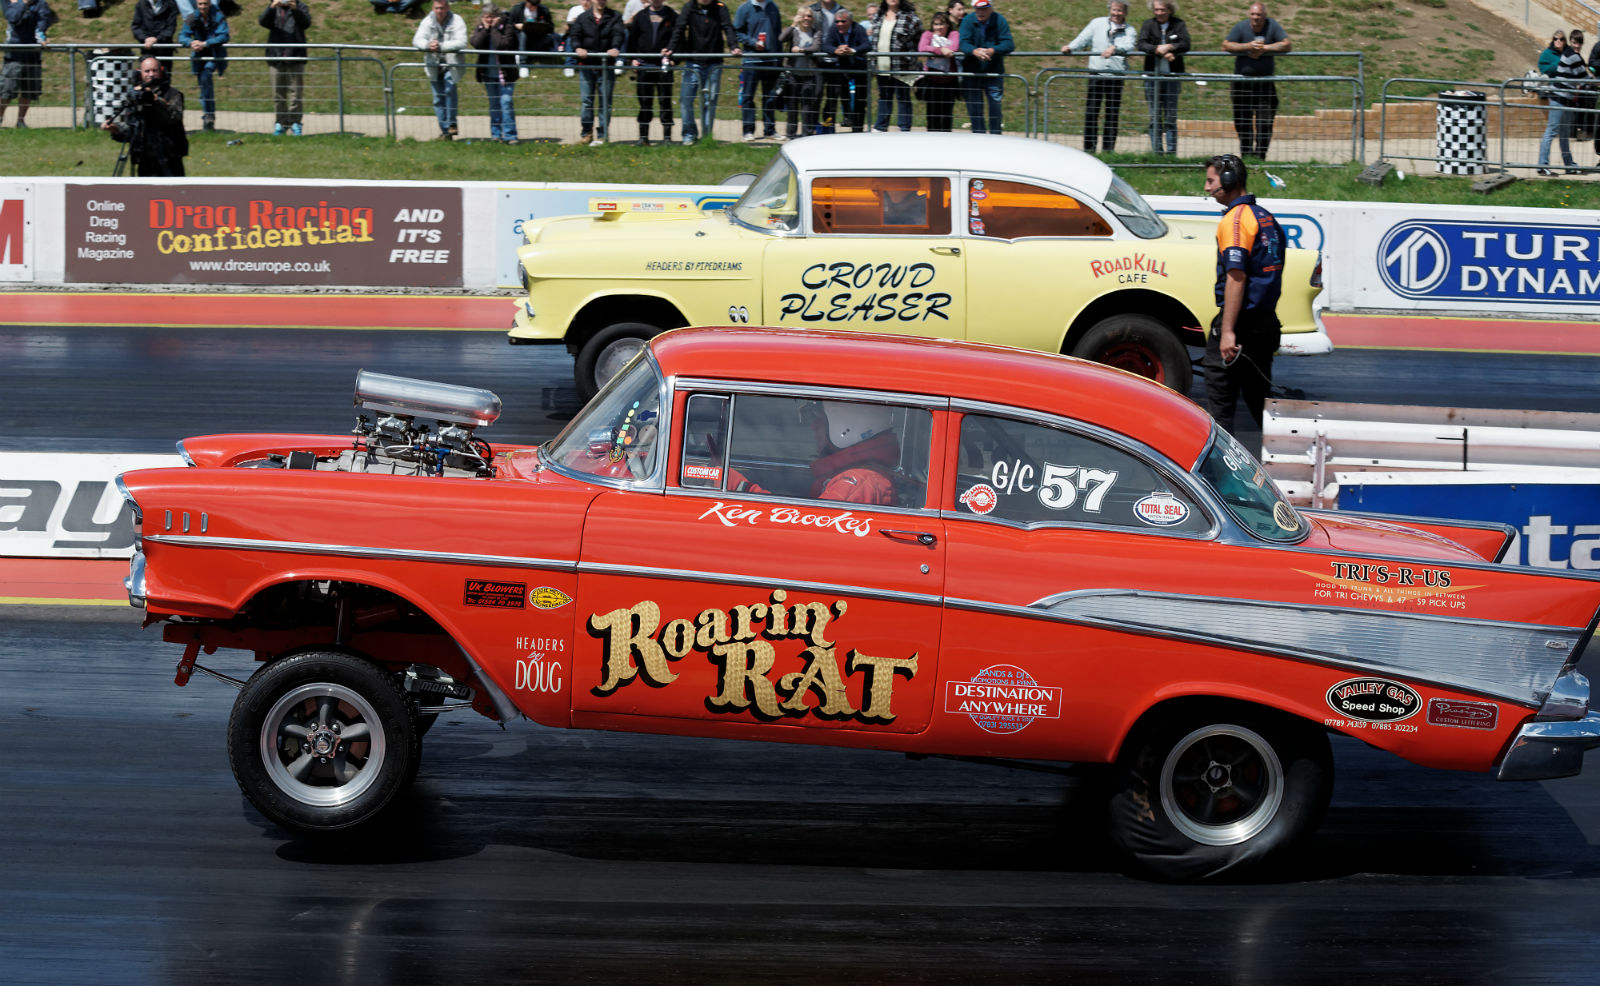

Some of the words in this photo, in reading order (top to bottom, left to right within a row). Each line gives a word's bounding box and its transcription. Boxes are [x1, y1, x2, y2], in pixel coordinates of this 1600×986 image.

[87, 200, 125, 212] Online
[90, 216, 119, 229] Drag
[149, 199, 237, 233] Drag
[249, 200, 373, 236] Racing
[394, 208, 444, 223] AND
[85, 232, 127, 246] Racing
[157, 218, 375, 255] Confidential
[397, 229, 442, 243] IT'S
[78, 247, 134, 261] Magazine
[1462, 231, 1600, 262] TUR
[389, 249, 450, 264] FREE
[190, 259, 331, 274] www.drceurope.co.uk
[645, 261, 683, 271] HEADERS
[685, 262, 695, 271] BY
[695, 262, 743, 271] PIPEDREAMS
[801, 262, 936, 289] CROWD
[1118, 273, 1148, 284] CAFE
[779, 292, 952, 322] PLEASER
[991, 459, 1035, 495] G/C
[1037, 462, 1119, 513] 57
[1141, 503, 1162, 514] TOTAL
[1164, 504, 1182, 516] SEAL
[698, 501, 763, 527] Ken
[769, 507, 874, 537] Brookes
[483, 583, 524, 594] BLOWERS
[1315, 590, 1331, 598] FOR
[1335, 591, 1348, 600] TRI
[1351, 592, 1384, 602] CHEVYS
[1417, 598, 1426, 606] 59
[1429, 599, 1447, 608] PICK
[1450, 600, 1466, 609] UPS
[516, 637, 564, 652] HEADERS
[515, 660, 562, 693] DOUG
[980, 669, 1006, 678] BANDS
[704, 640, 919, 725] RAT
[955, 684, 1053, 701] DESTINATION
[1335, 682, 1386, 700] VALLEY
[1386, 685, 1415, 706] GAS
[958, 700, 1048, 716] ANYWHERE
[1341, 700, 1375, 712] Speed
[1378, 703, 1405, 715] Shop
[1324, 718, 1345, 727] 07789
